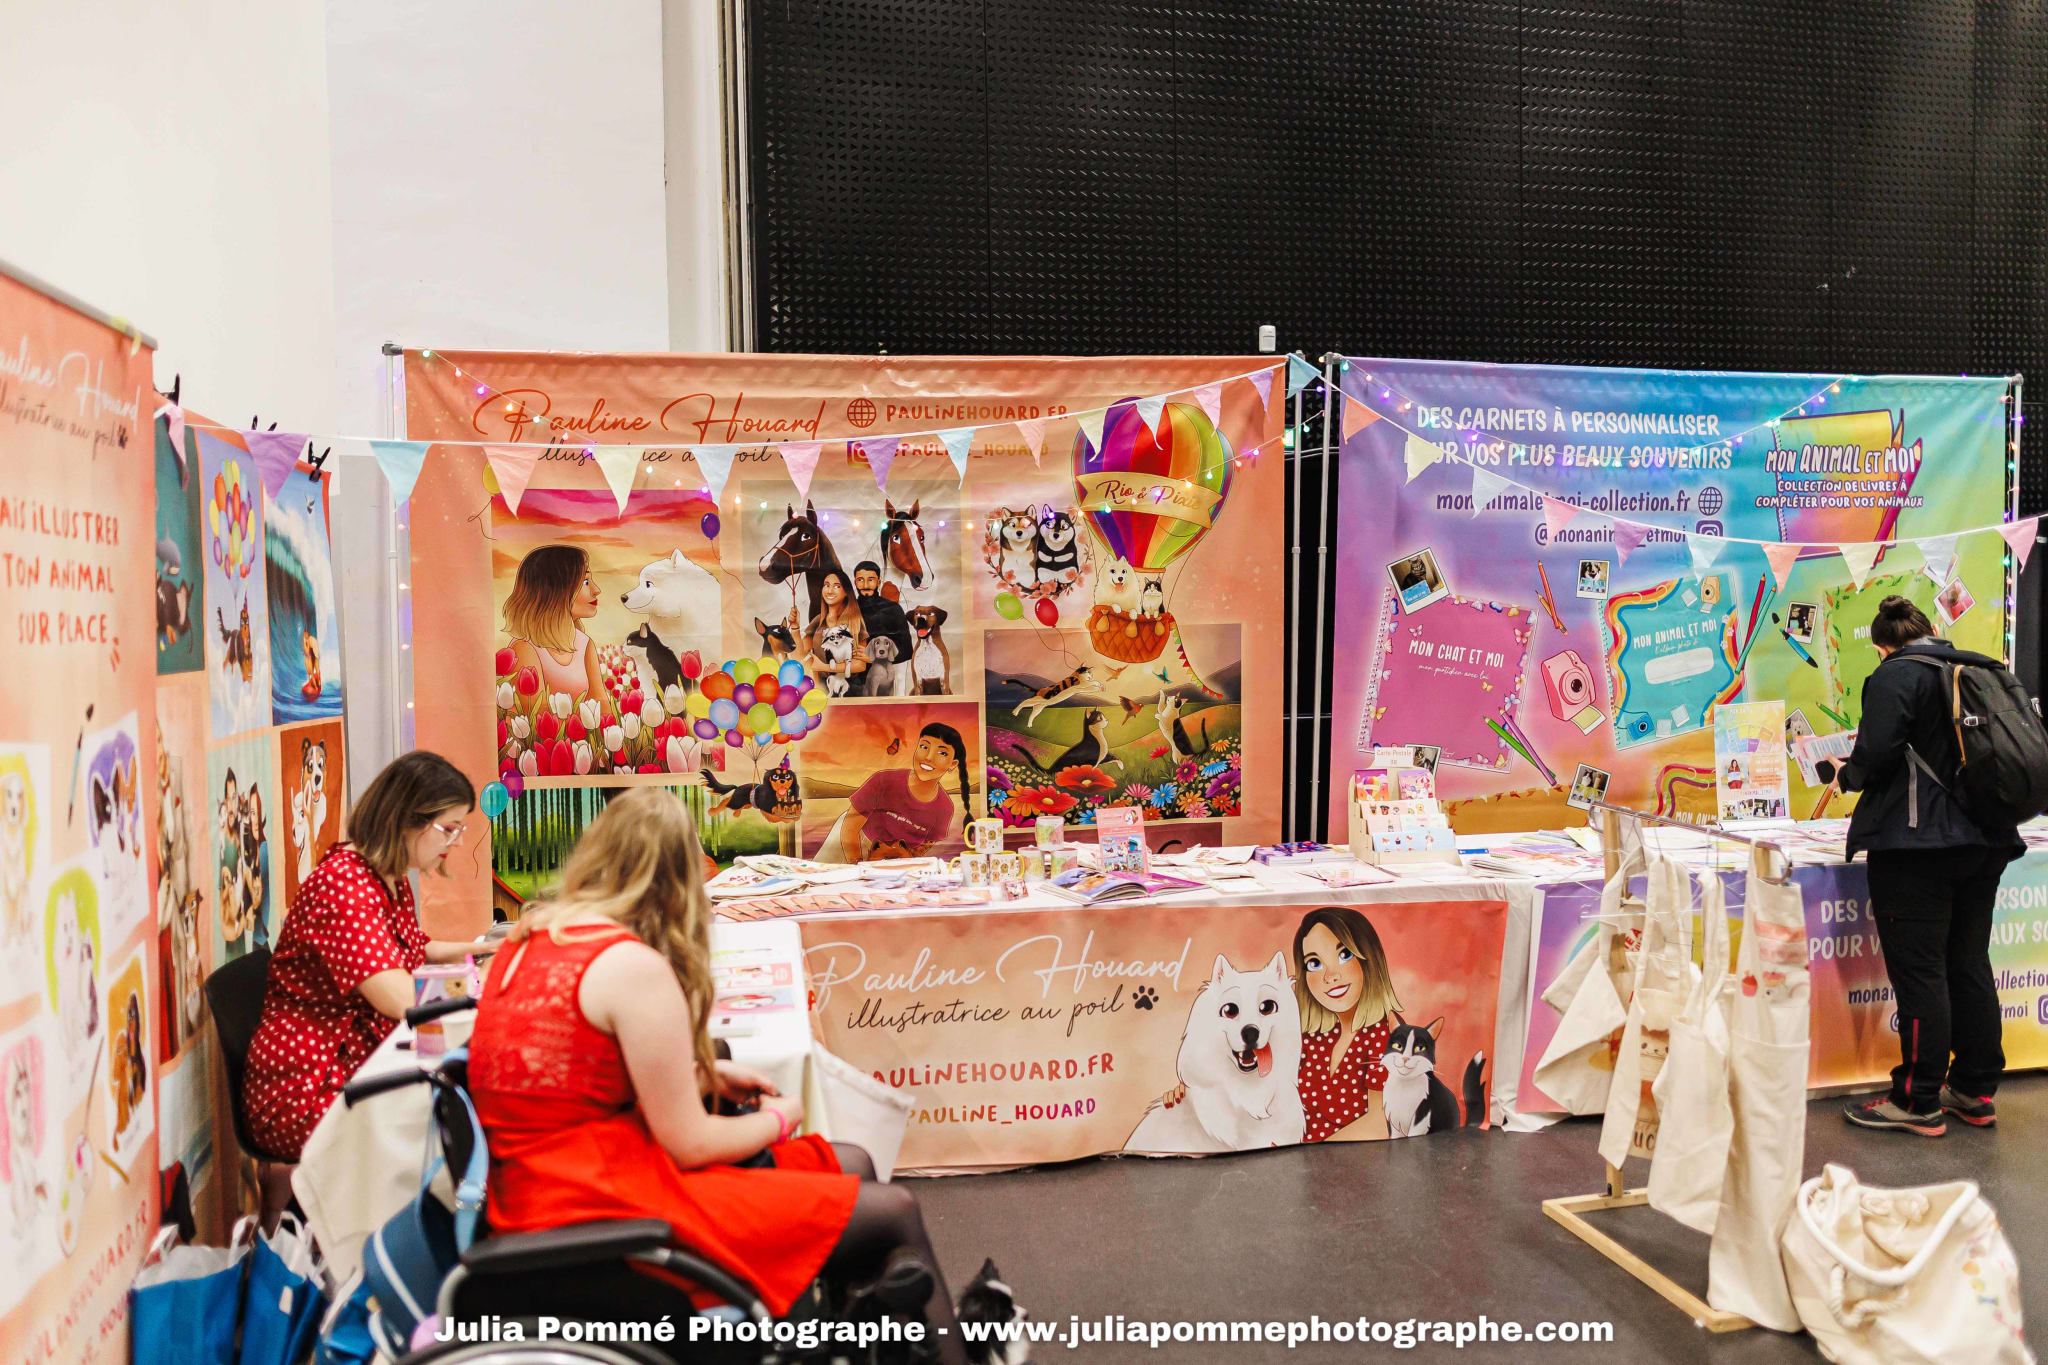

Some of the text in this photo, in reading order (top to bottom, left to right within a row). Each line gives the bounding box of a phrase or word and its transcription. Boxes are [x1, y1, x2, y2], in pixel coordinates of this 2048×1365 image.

[473, 389, 826, 443] Pauline Houard
[887, 405, 1068, 422] PAULiNEHOUARDFR
[1417, 405, 1720, 436] DES CARNETS À PERSONNALISER
[1464, 442, 1501, 466] VOS
[1507, 443, 1557, 467] PLUS
[1561, 443, 1625, 468] BEAUX
[1629, 444, 1733, 470] SOUVENIRS
[1766, 444, 1916, 474] MON ANIMAL ET MOI
[1096, 479, 1134, 505] Rio
[1150, 484, 1200, 510] Pixie
[1844, 480, 1858, 492] DE
[1900, 477, 1908, 492] À
[1755, 494, 1819, 508] COMPLÉTER
[1820, 496, 1851, 508] POUR
[1853, 496, 1875, 508] VOS
[2, 552, 40, 591] TON
[18, 611, 51, 645] SUR
[1632, 636, 1652, 649] MON
[1655, 625, 1687, 645] ANIMAL
[1688, 622, 1699, 637] ET
[1702, 618, 1718, 633] MOI
[1408, 639, 1505, 668] MON CHAT ET MOI
[1676, 811, 1694, 825] MON
[1820, 898, 1859, 924] DES
[1995, 885, 2048, 910] RSON
[1809, 934, 1864, 961] POUR
[801, 929, 1192, 1015] Pauline Houard
[847, 983, 1125, 1038] illustratrice au poil
